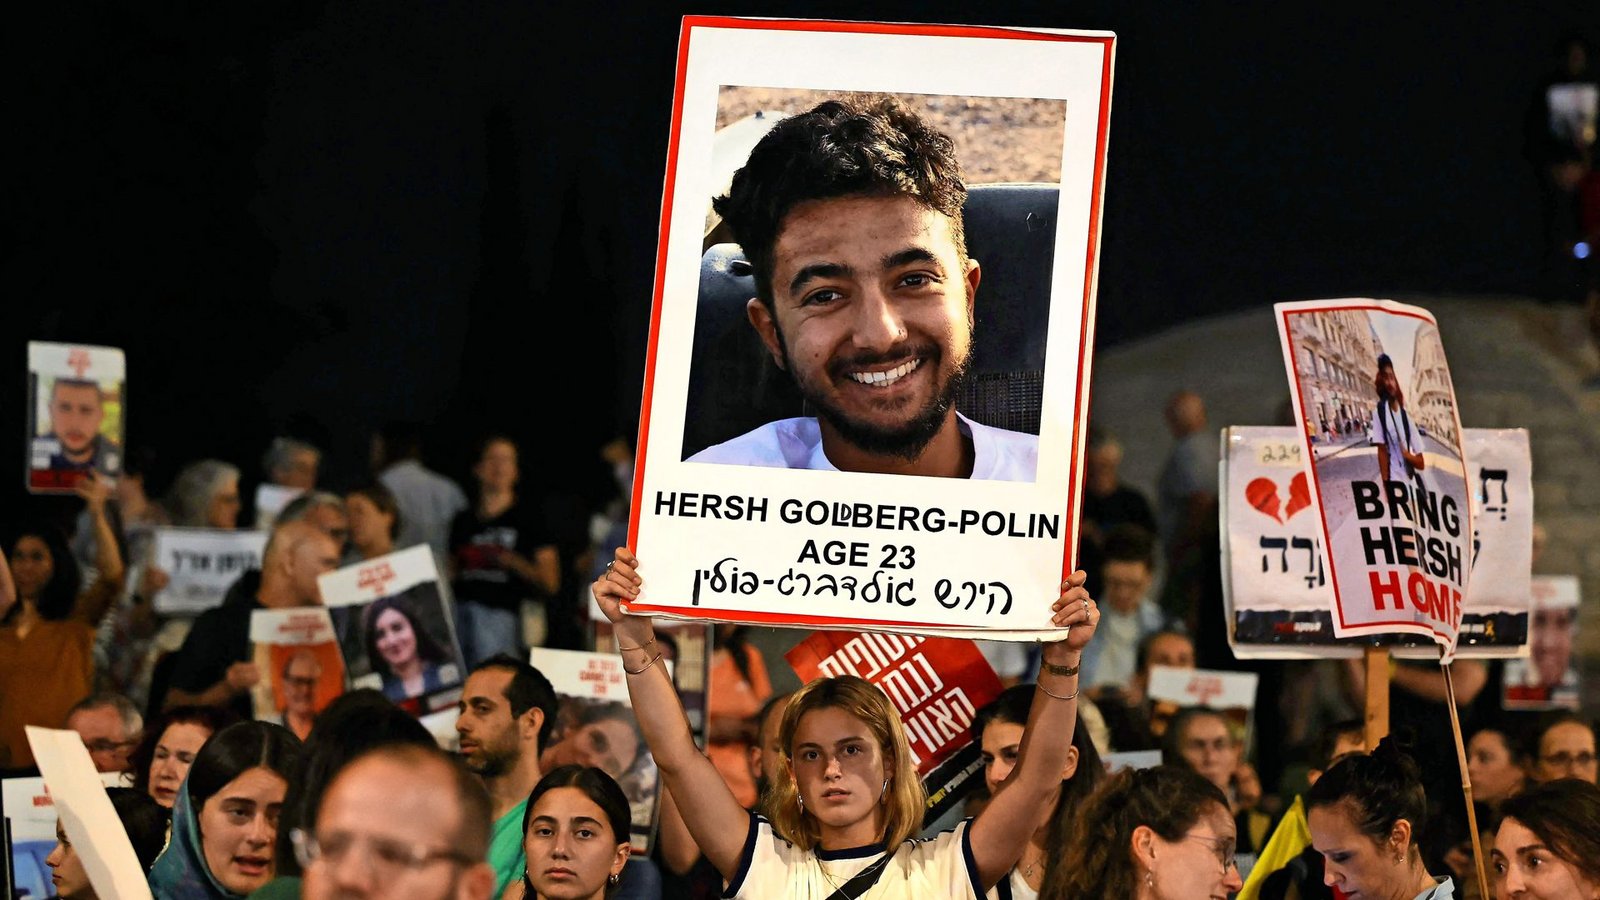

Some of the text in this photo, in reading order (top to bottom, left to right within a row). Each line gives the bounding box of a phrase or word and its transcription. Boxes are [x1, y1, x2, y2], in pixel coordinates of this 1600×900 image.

[654, 491, 1060, 539] HERSH GOLDBERG-POLIN
[1351, 480, 1460, 538] BRING
[797, 539, 916, 570] AGE 23
[1360, 526, 1462, 587] HERSH
[691, 557, 1013, 615] הירש גולדברג-פולין
[1368, 570, 1462, 632] HOME
